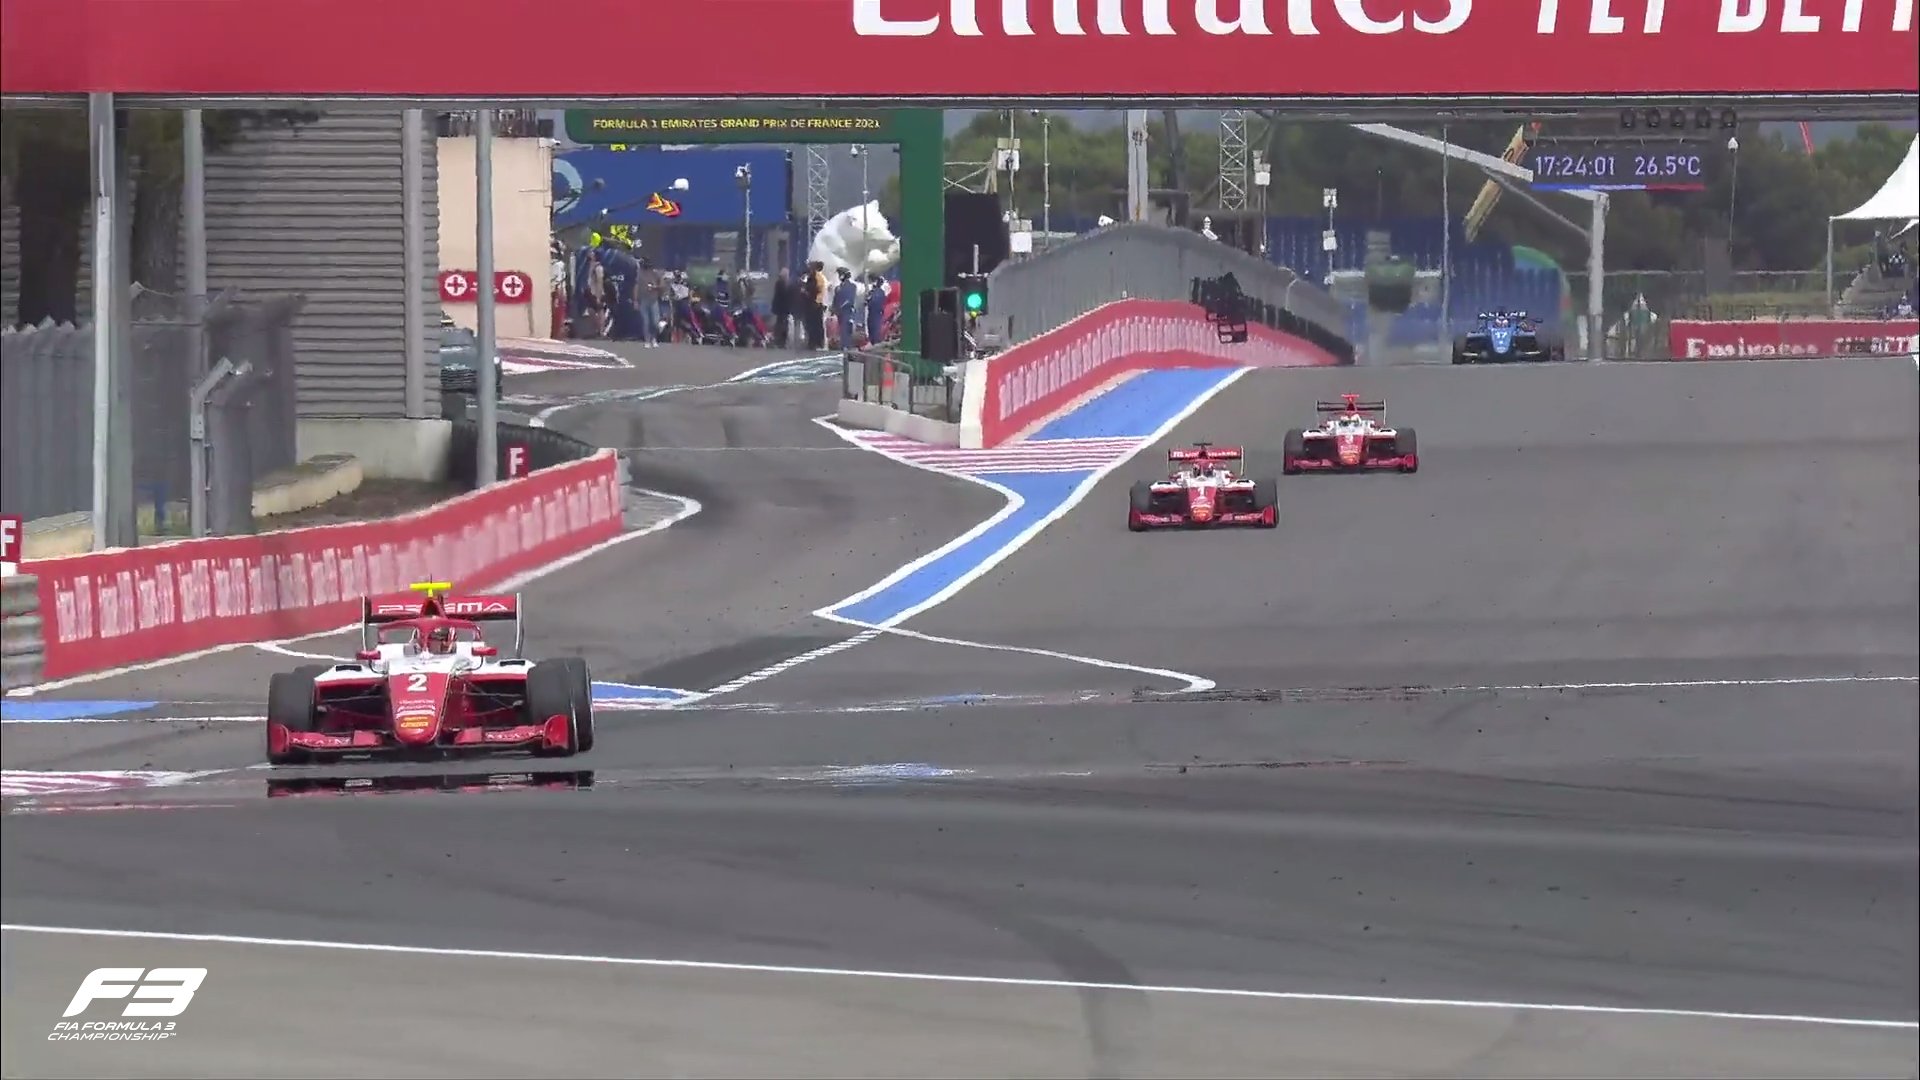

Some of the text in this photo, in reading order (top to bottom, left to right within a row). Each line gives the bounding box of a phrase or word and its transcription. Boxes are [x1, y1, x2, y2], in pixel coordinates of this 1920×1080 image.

[593, 118, 881, 129] FORMULA 1 EMIRATES GRAND PRIX DE FRANCE 2021
[1535, 156, 1701, 176] 17:24:01 26.5°C
[510, 447, 524, 476] F
[1, 519, 17, 557] F
[407, 673, 428, 692] 2
